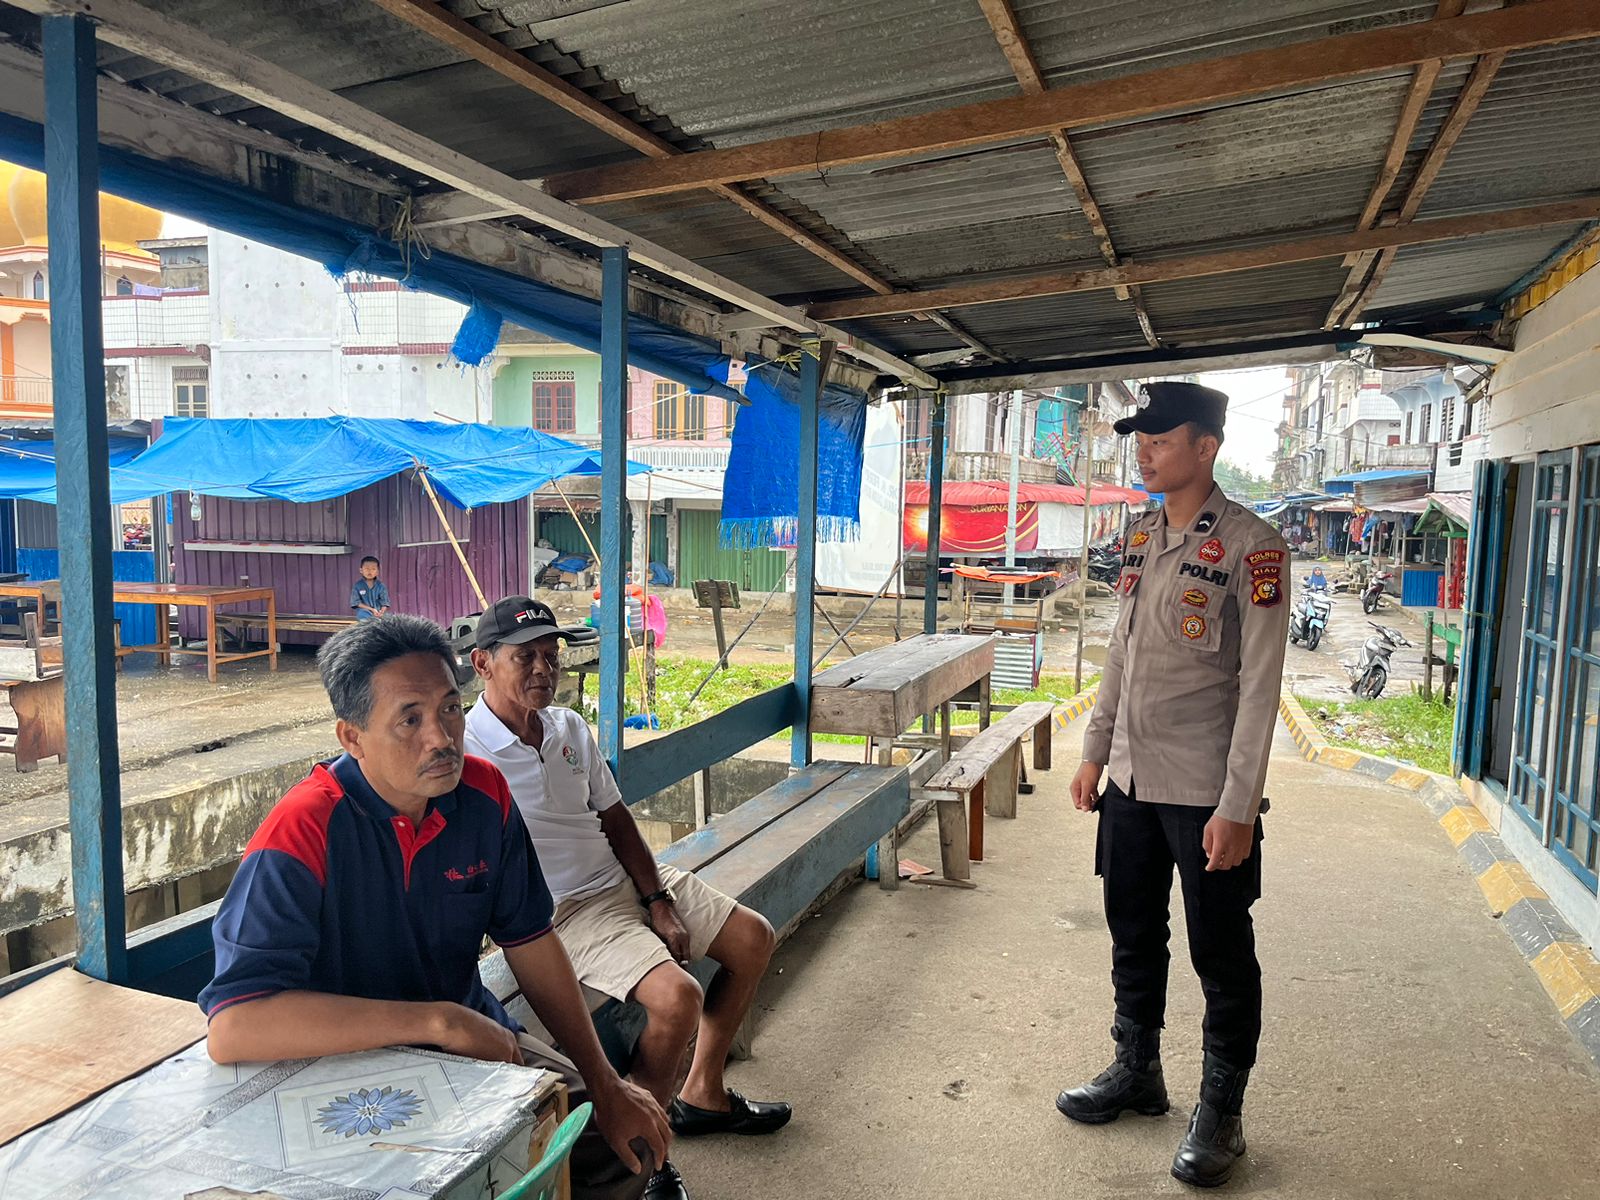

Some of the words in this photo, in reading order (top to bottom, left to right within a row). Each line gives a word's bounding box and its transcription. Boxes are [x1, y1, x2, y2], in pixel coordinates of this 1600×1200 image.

[1179, 562, 1229, 586] POLRI
[1253, 568, 1277, 576] RIAU
[514, 609, 550, 623] FILA
